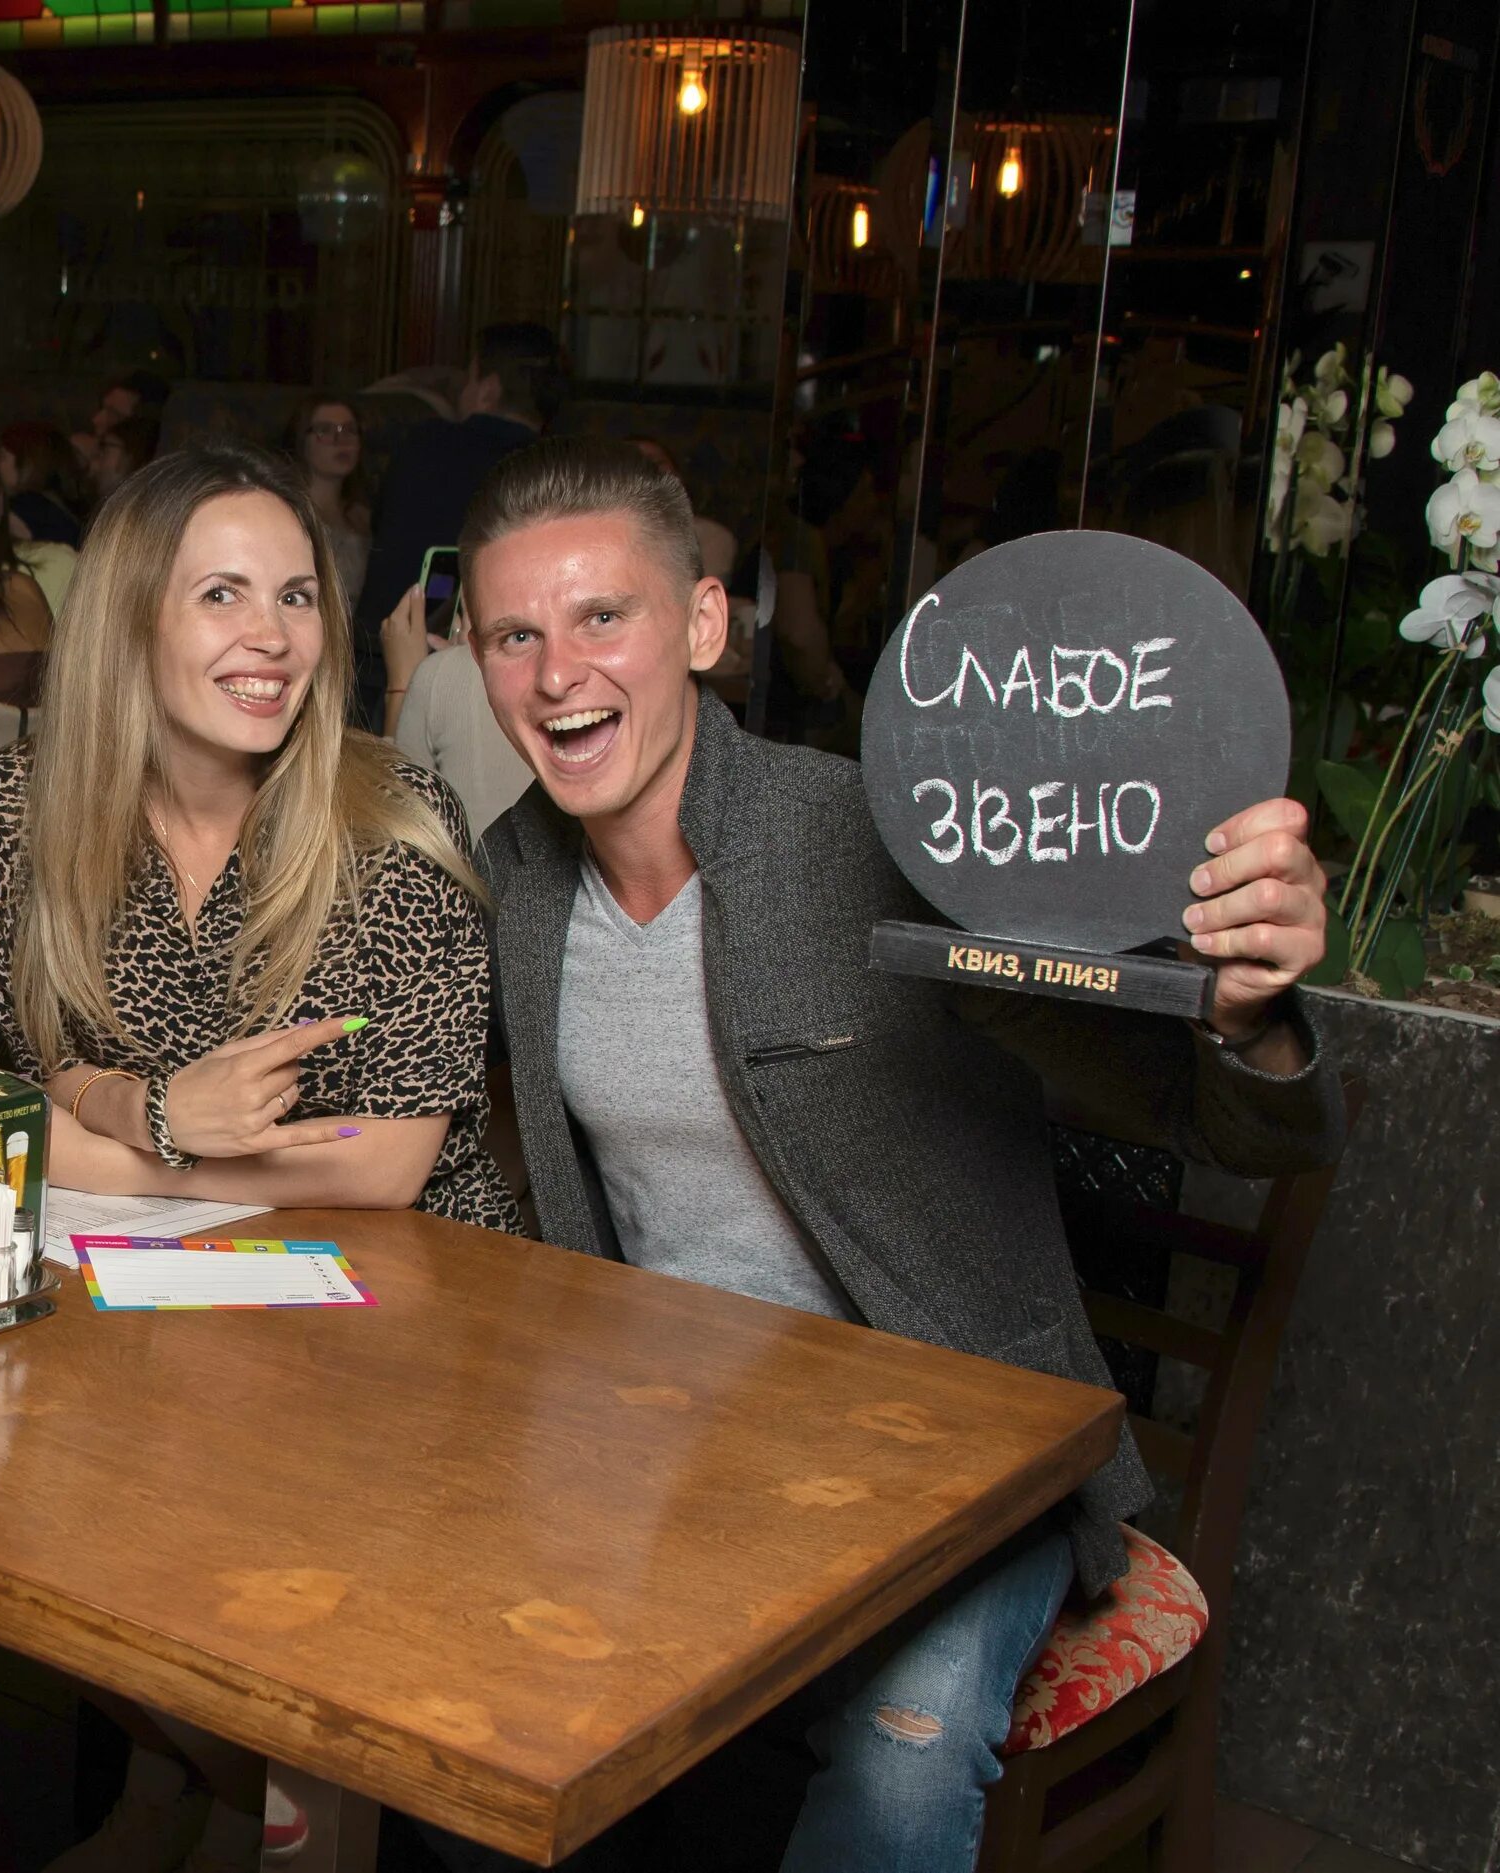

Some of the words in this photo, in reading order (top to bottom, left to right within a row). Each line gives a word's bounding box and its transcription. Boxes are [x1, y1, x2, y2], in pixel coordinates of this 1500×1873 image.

[900, 592, 1178, 718] СЛАБОЕ
[912, 777, 1161, 866] ЗВЕНО
[947, 945, 1025, 981] КВИЗ,
[1033, 957, 1120, 994] ПЛИЗ!
[13, 1105, 29, 1117] ИМЕЕТ
[29, 1102, 41, 1113] ИМЯ
